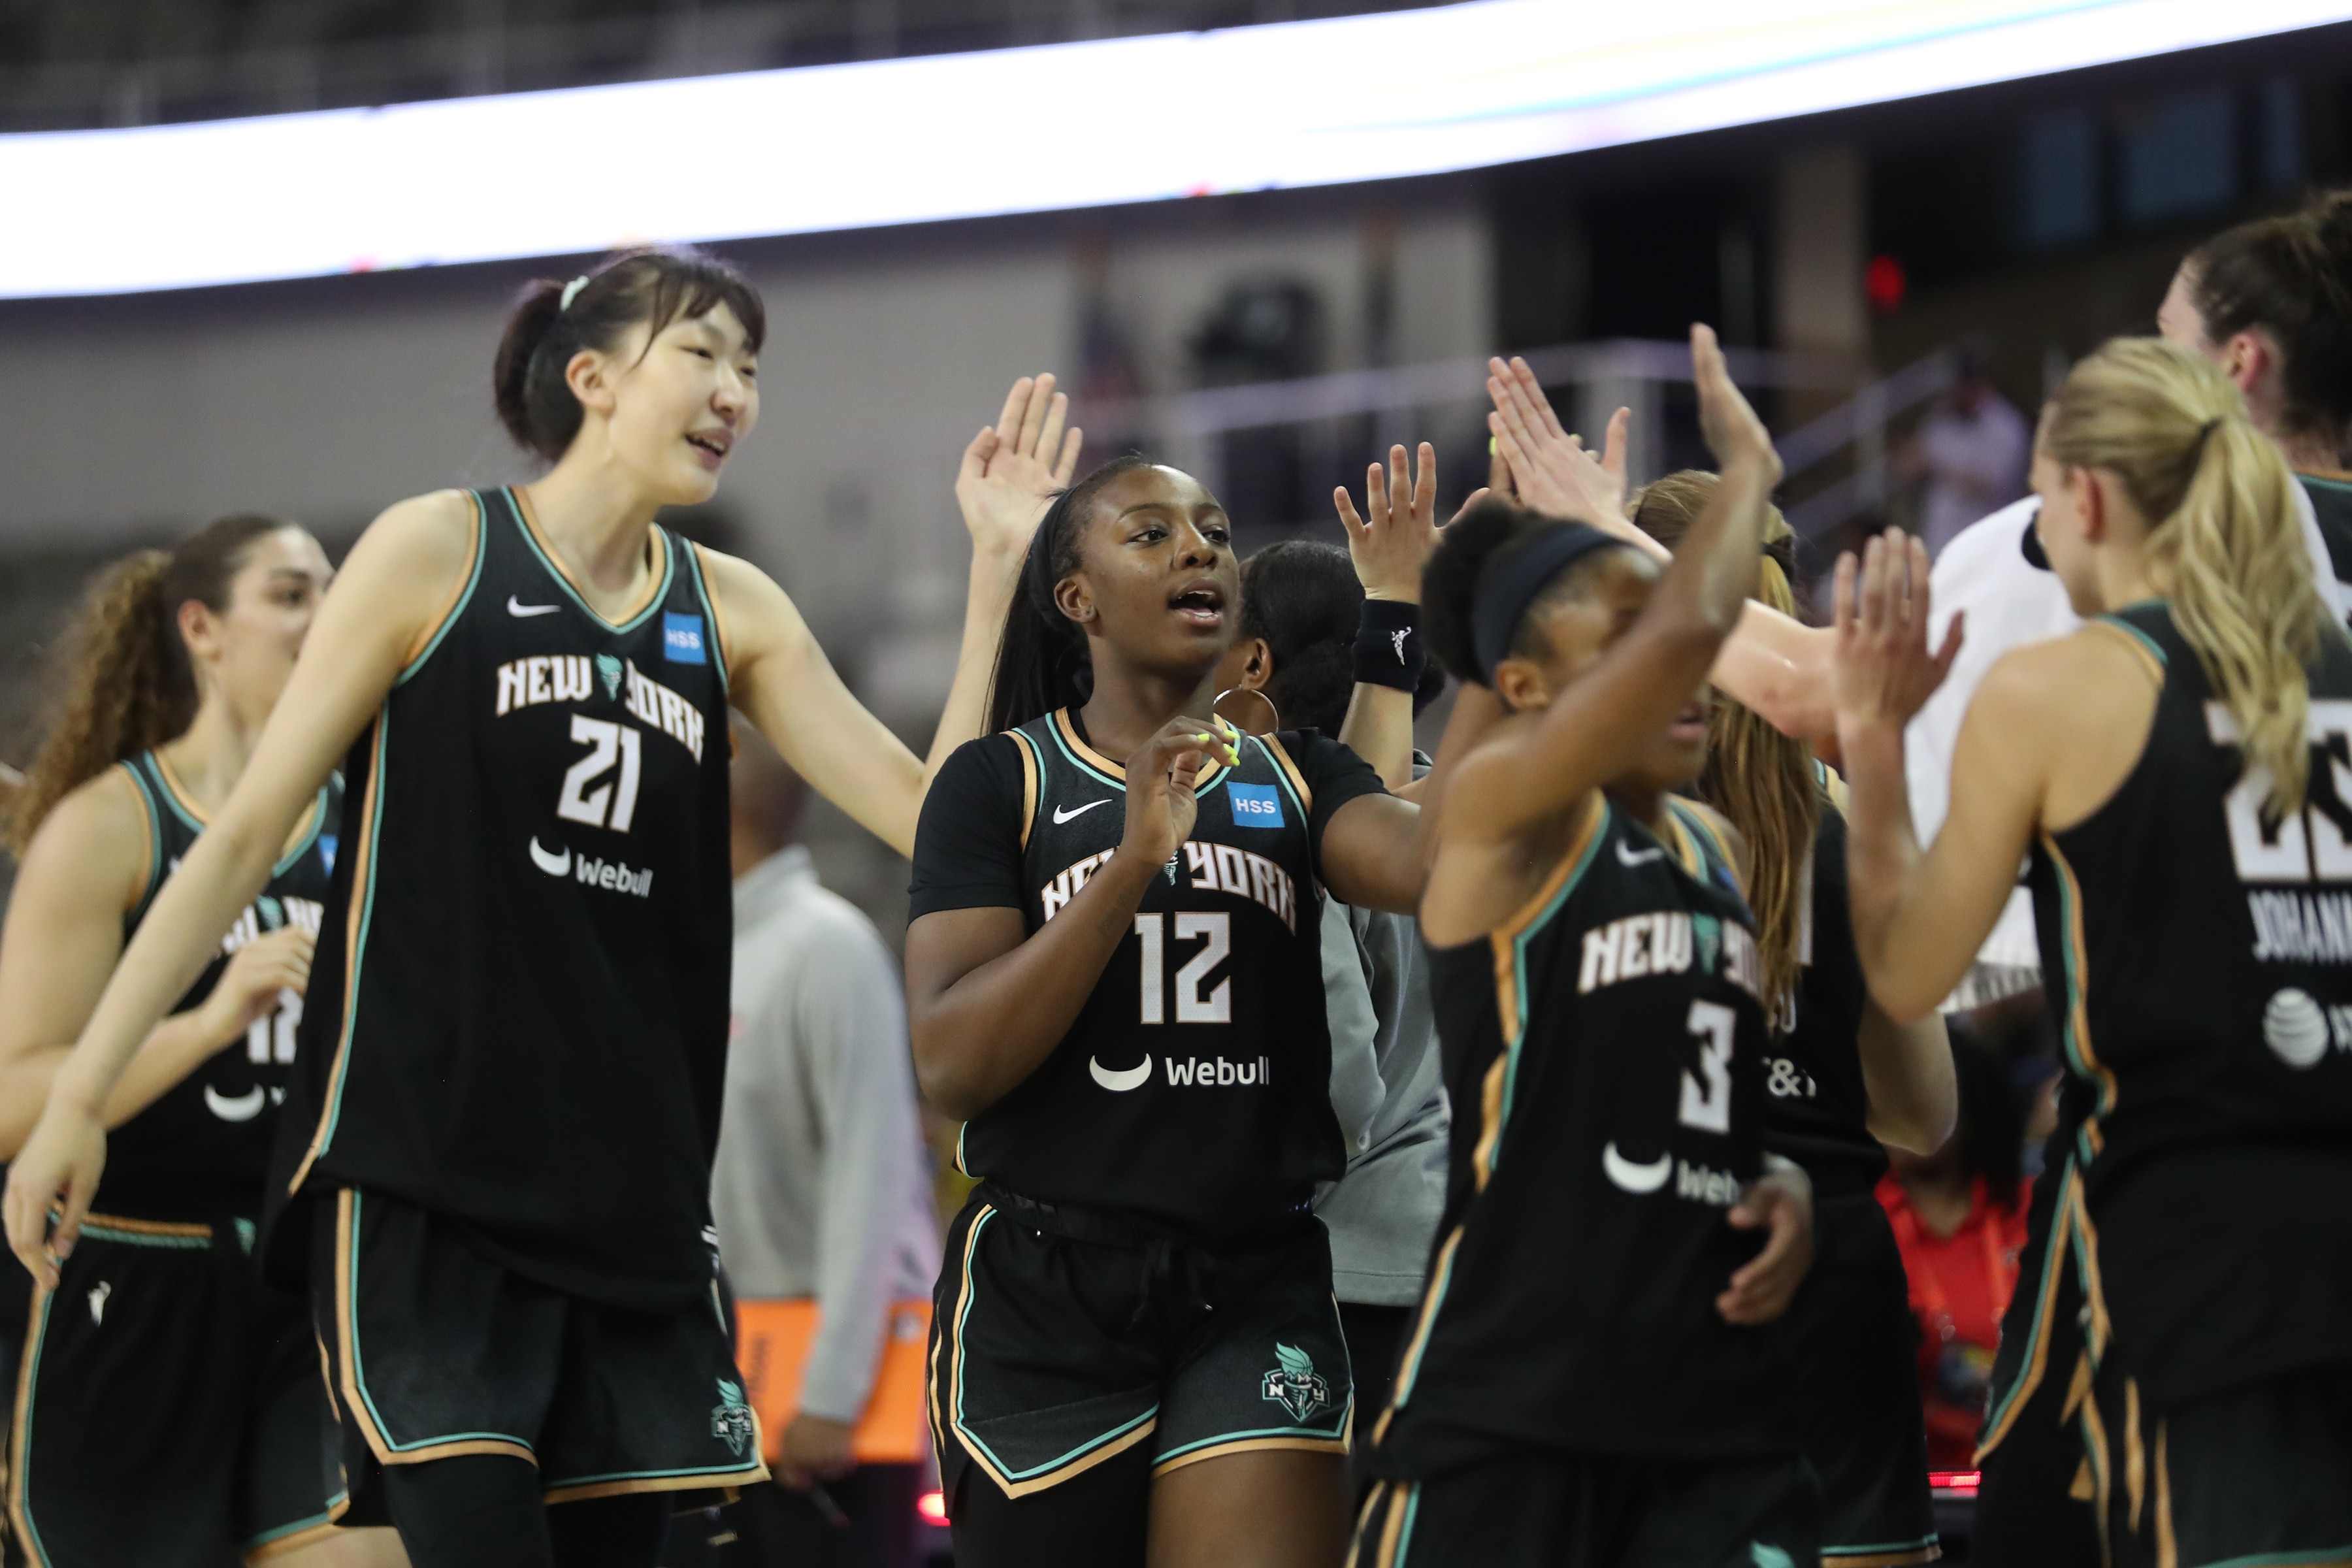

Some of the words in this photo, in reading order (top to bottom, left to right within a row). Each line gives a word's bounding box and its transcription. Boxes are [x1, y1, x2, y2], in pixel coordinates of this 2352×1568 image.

[664, 627, 701, 651] HSS
[497, 655, 593, 717] NEW
[624, 657, 705, 766] YORK
[557, 713, 642, 834] 21
[1235, 798, 1277, 815] HSS
[576, 853, 653, 898] Webull
[1183, 840, 1297, 936] YORK
[1135, 911, 1232, 1024] 12
[1577, 911, 1693, 996] NEW
[1166, 1055, 1270, 1086] Webull
[1678, 998, 1737, 1135] 3
